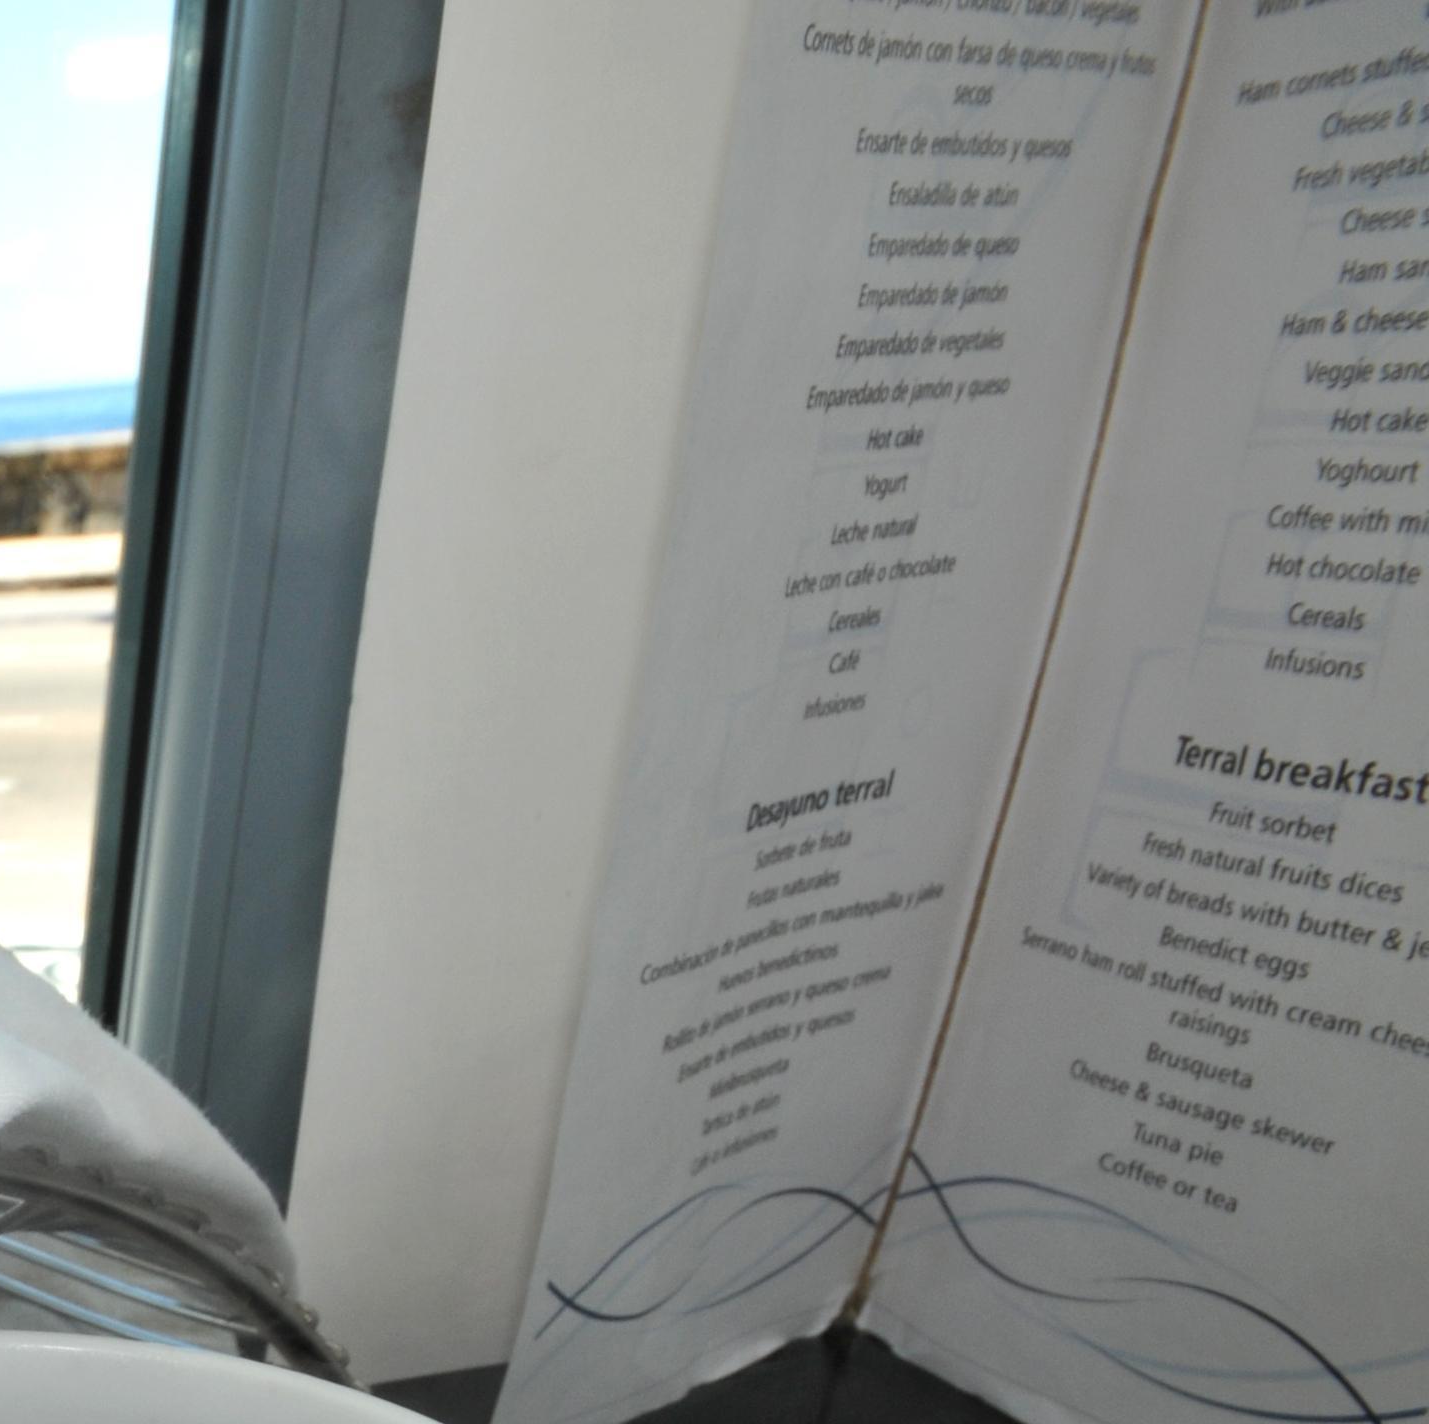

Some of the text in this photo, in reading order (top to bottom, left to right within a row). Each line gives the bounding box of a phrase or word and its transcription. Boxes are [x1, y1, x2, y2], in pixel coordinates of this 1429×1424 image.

[804, 24, 853, 57] Cornets
[858, 30, 874, 60] de
[876, 34, 921, 65] jamón
[927, 42, 951, 62] con
[957, 36, 991, 65] farsa
[996, 40, 1015, 68] de
[1020, 50, 1060, 71] queso
[1066, 52, 1105, 71] crema
[1106, 56, 1118, 77] y
[955, 84, 992, 105] secos
[1237, 81, 1280, 106] Ham
[1287, 65, 1357, 96] cornets
[1322, 110, 1391, 140] Cheese
[1397, 101, 1412, 126] &
[857, 127, 1073, 162] Ensarte de embutidos y quesos
[1294, 161, 1342, 191] Fresh
[890, 181, 1019, 206] Ensaladilla de atún
[1340, 208, 1415, 235] Cheese
[868, 230, 1019, 261] Emparedado de queso
[1339, 260, 1388, 284] Ham
[858, 280, 1007, 313] Emparedado de jamón
[1280, 307, 1429, 337] Ham & cheese
[836, 327, 1005, 361] Emparedado de vegetales
[1305, 356, 1374, 390] Veggie
[807, 377, 1011, 414] Emparedado de jamón y queso
[1329, 406, 1429, 433] Hot cake
[868, 425, 923, 449] Hot cake
[865, 473, 907, 500] Yogurt
[1317, 457, 1419, 489] Yoghourt
[831, 513, 918, 545] Leche natural
[1267, 504, 1333, 531] Coffee
[1340, 507, 1390, 532] with
[785, 553, 956, 598] Leche con café o chocolate
[1265, 552, 1421, 585] Hot chocolate
[829, 606, 881, 632] Cereales
[1289, 602, 1366, 631] Cereals
[829, 650, 860, 674] Café
[1264, 648, 1366, 680] Infusions
[1174, 735, 1429, 805] Terral breakfast
[747, 767, 895, 832] Desayuno terral
[1208, 802, 1337, 845] Fruit sorbet
[755, 831, 851, 871] Sorbete de fruta
[782, 869, 840, 897] naturales
[1143, 832, 1404, 904] Fresh natural fruits dices
[1089, 860, 1141, 899] Variety
[1143, 879, 1165, 898] of
[1167, 882, 1233, 917] breads
[1240, 901, 1290, 928] with
[1297, 911, 1376, 947] butter
[1382, 928, 1403, 950] &
[720, 939, 734, 955] de
[792, 914, 816, 932] con
[820, 891, 902, 924] mantequilla
[903, 894, 914, 910] y
[757, 944, 838, 977] benedictinos
[1159, 925, 1310, 982] Benedict eggs
[791, 989, 803, 1006] y
[806, 977, 849, 999] queso
[1022, 926, 1078, 961] Serrano
[1081, 945, 1114, 974] ham
[1117, 962, 1147, 983] roll
[1149, 969, 1224, 1003] stuffed
[1229, 990, 1280, 1016] with
[1286, 1005, 1362, 1037] cream
[792, 1023, 804, 1041] y
[807, 1010, 855, 1035] quesos
[1169, 1009, 1251, 1047] raisings
[1146, 1041, 1253, 1090] Brusqueta
[1070, 1059, 1336, 1155] Cheese & sausage skewer
[1133, 1122, 1224, 1166] Tuna pie
[1098, 1152, 1238, 1214] Coffee or tea
